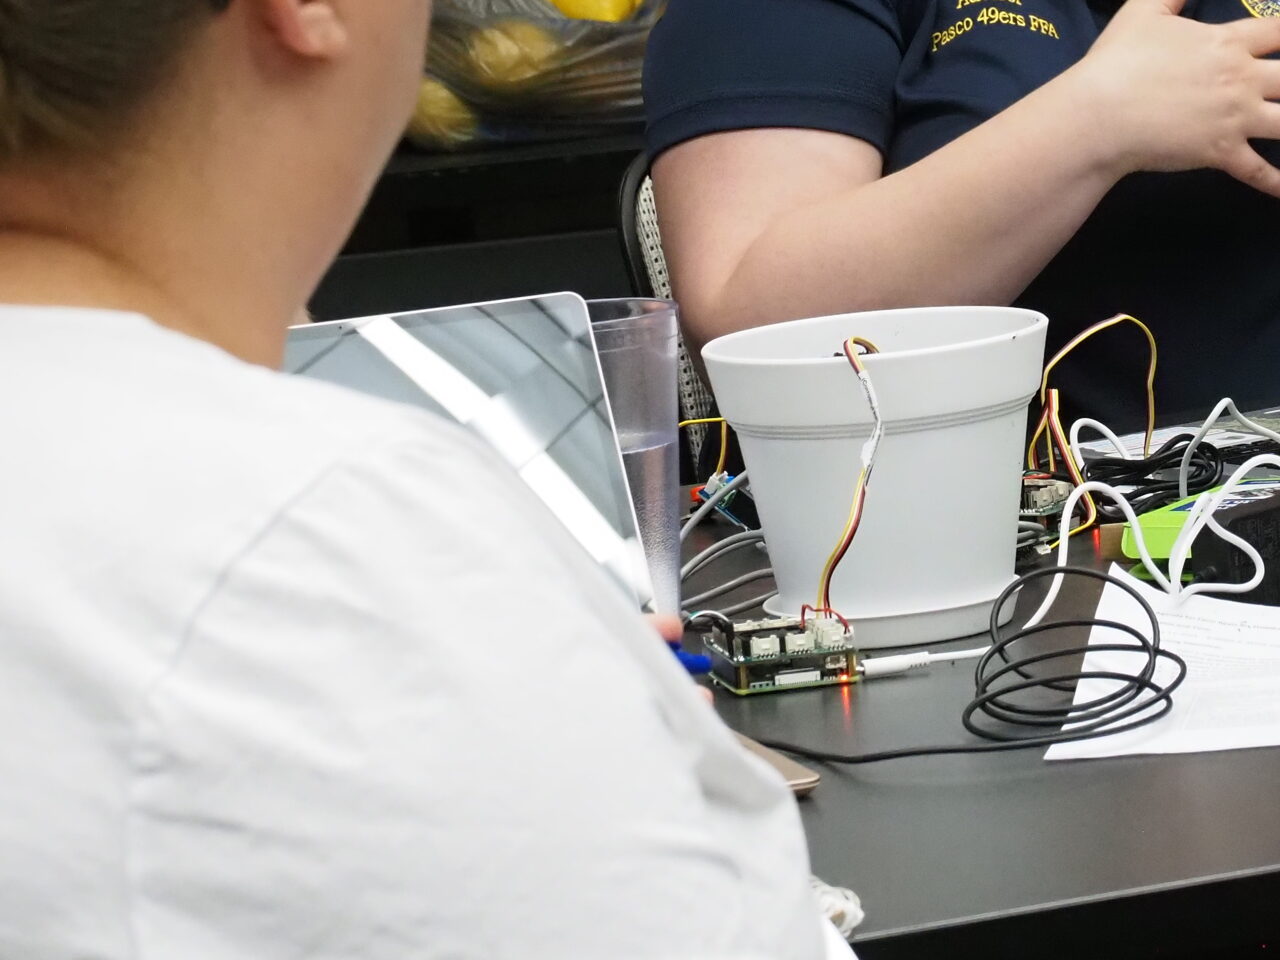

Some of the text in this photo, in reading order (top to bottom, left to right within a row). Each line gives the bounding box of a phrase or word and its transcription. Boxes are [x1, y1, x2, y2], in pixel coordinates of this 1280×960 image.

[931, 7, 1060, 52] Pasco 49ers FFA
